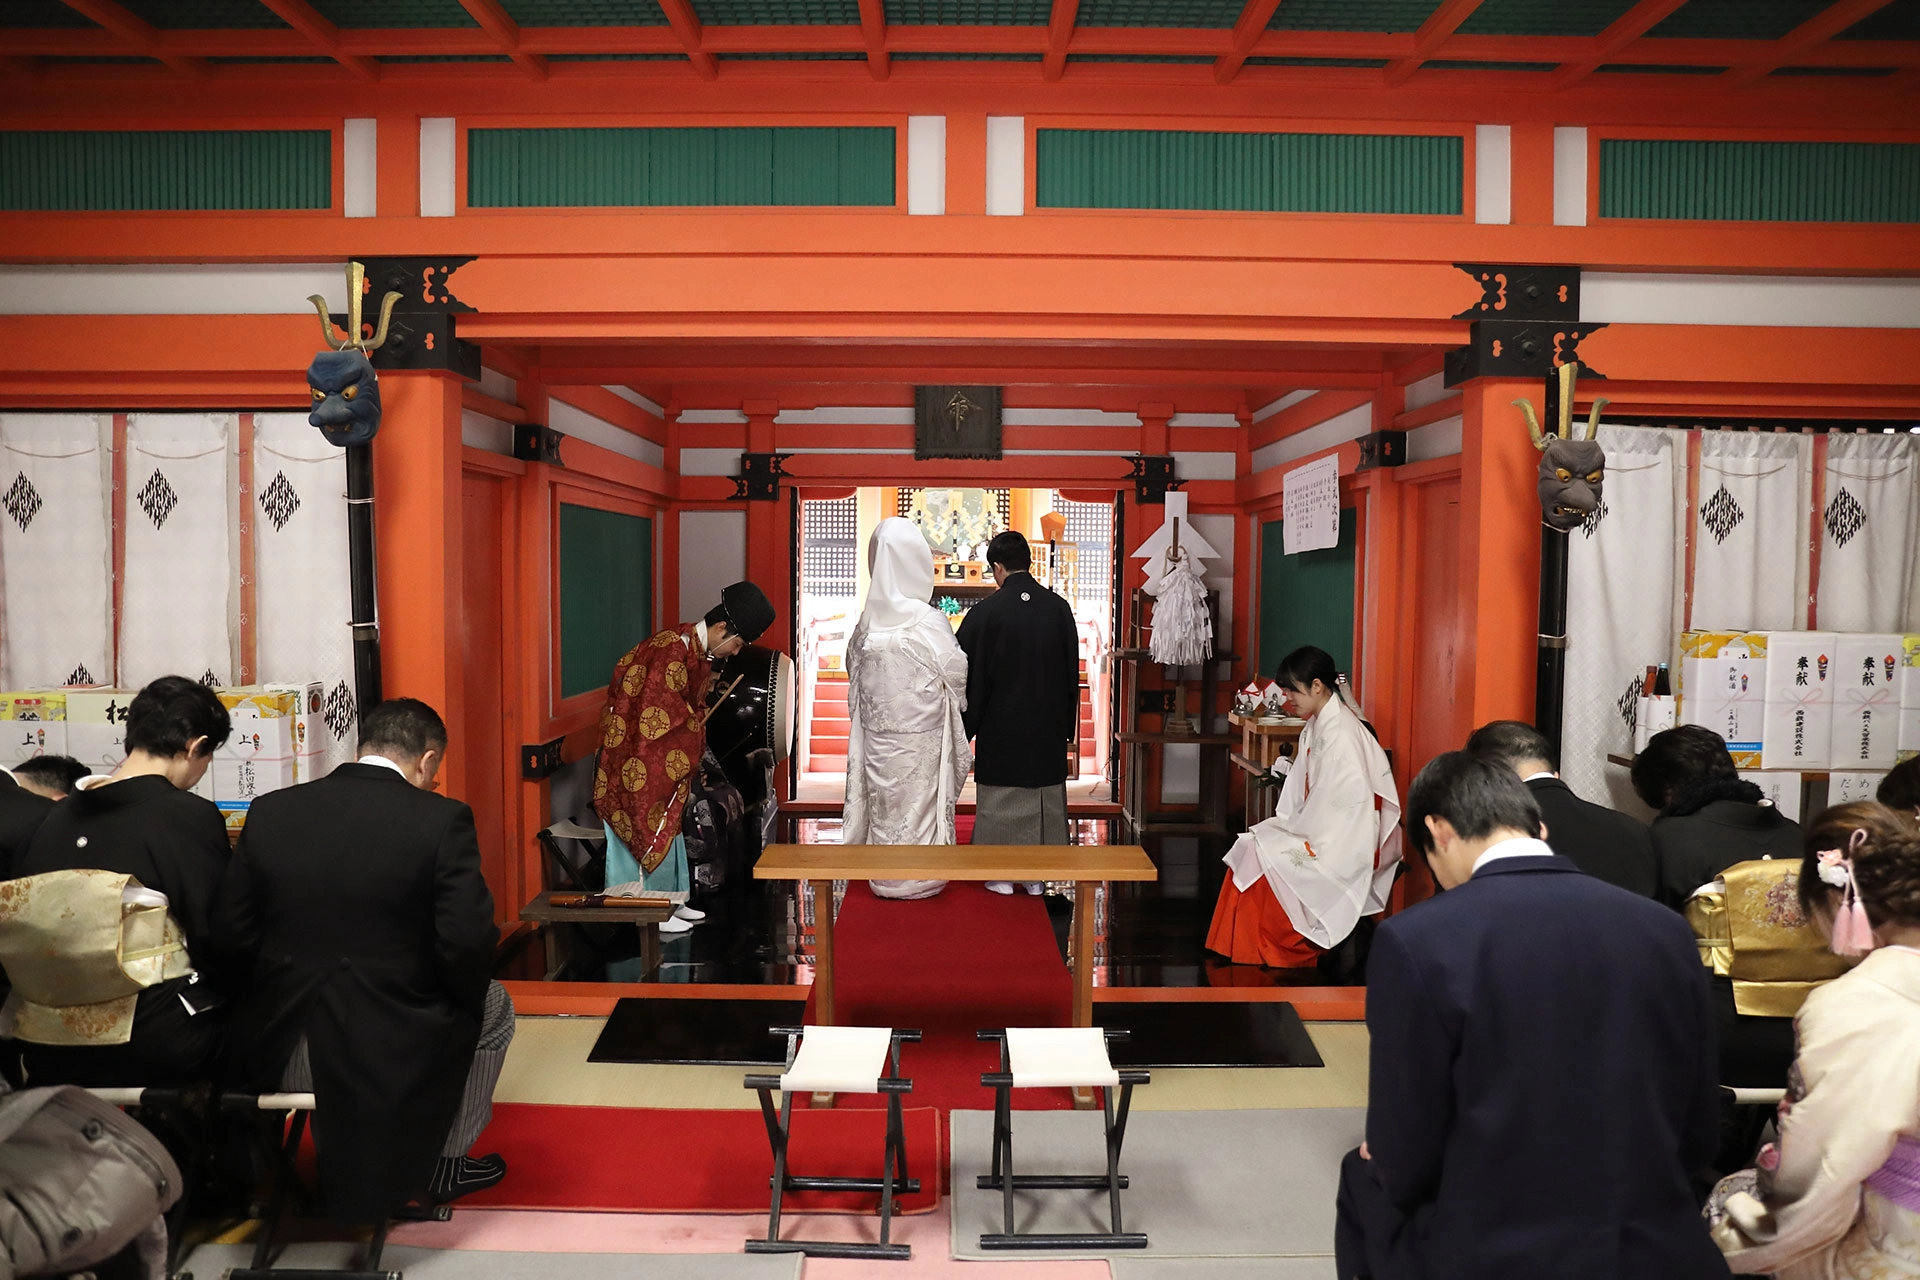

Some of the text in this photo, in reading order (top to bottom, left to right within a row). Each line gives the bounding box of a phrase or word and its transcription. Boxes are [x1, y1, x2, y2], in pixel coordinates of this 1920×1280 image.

[1795, 655, 1809, 687] 奉献
[1862, 656, 1876, 687] 奉献
[22, 733, 36, 746] 上
[238, 734, 252, 745] 上
